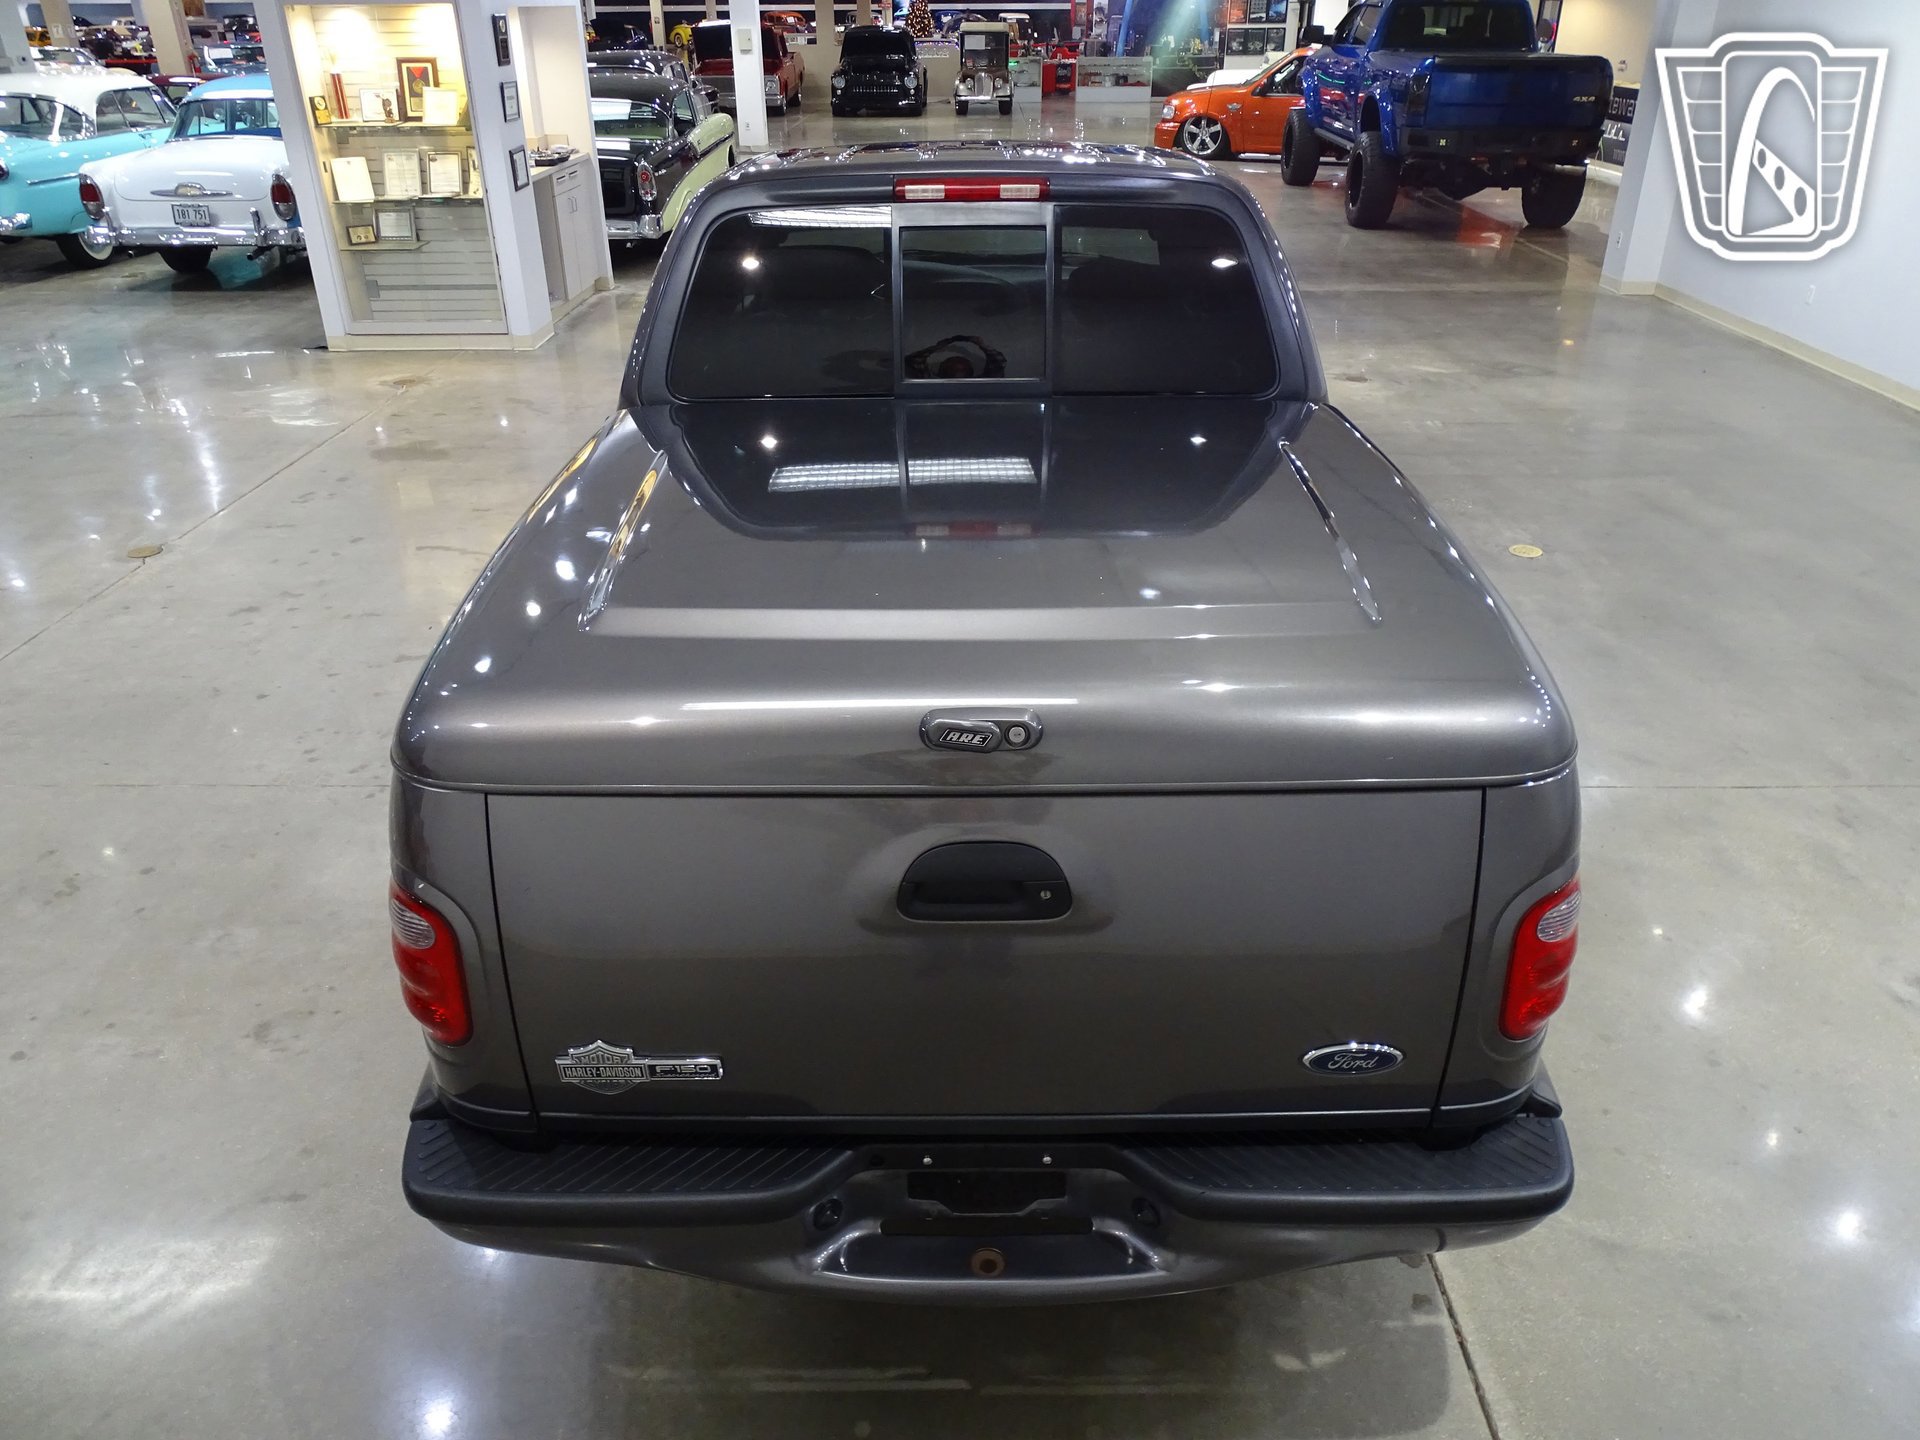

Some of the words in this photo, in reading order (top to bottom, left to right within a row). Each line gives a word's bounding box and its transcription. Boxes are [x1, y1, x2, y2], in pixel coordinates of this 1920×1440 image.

[1608, 97, 1636, 117] tewa
[177, 208, 190, 219] 181
[193, 209, 207, 220] 751
[580, 1051, 622, 1064] MOTOR
[1328, 1053, 1379, 1069] Ford
[565, 1067, 642, 1078] HARLEY-DAVIDSON
